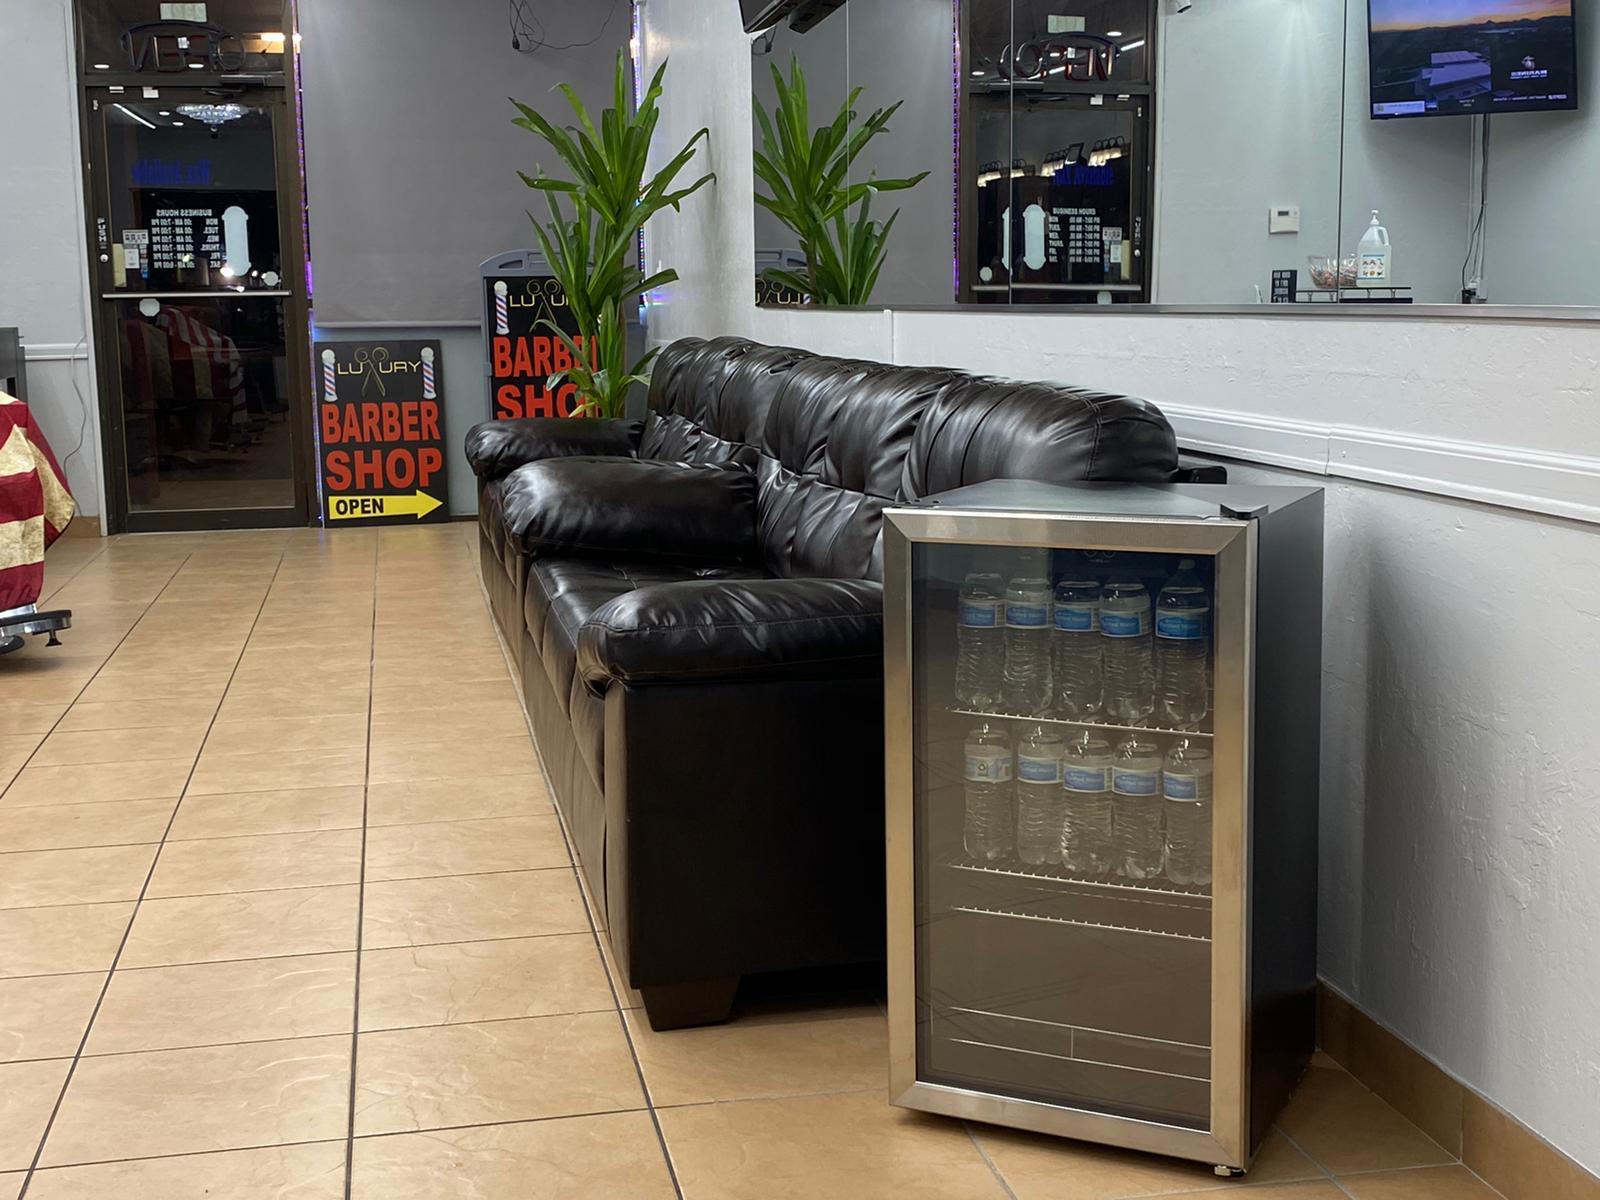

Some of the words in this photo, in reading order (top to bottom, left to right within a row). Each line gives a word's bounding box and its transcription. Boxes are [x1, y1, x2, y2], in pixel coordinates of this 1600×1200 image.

[493, 336, 598, 378] BARBE
[496, 382, 602, 420] SHO
[321, 401, 441, 444] BARBER
[325, 447, 442, 491] SHOP
[335, 498, 384, 515] OPEN
